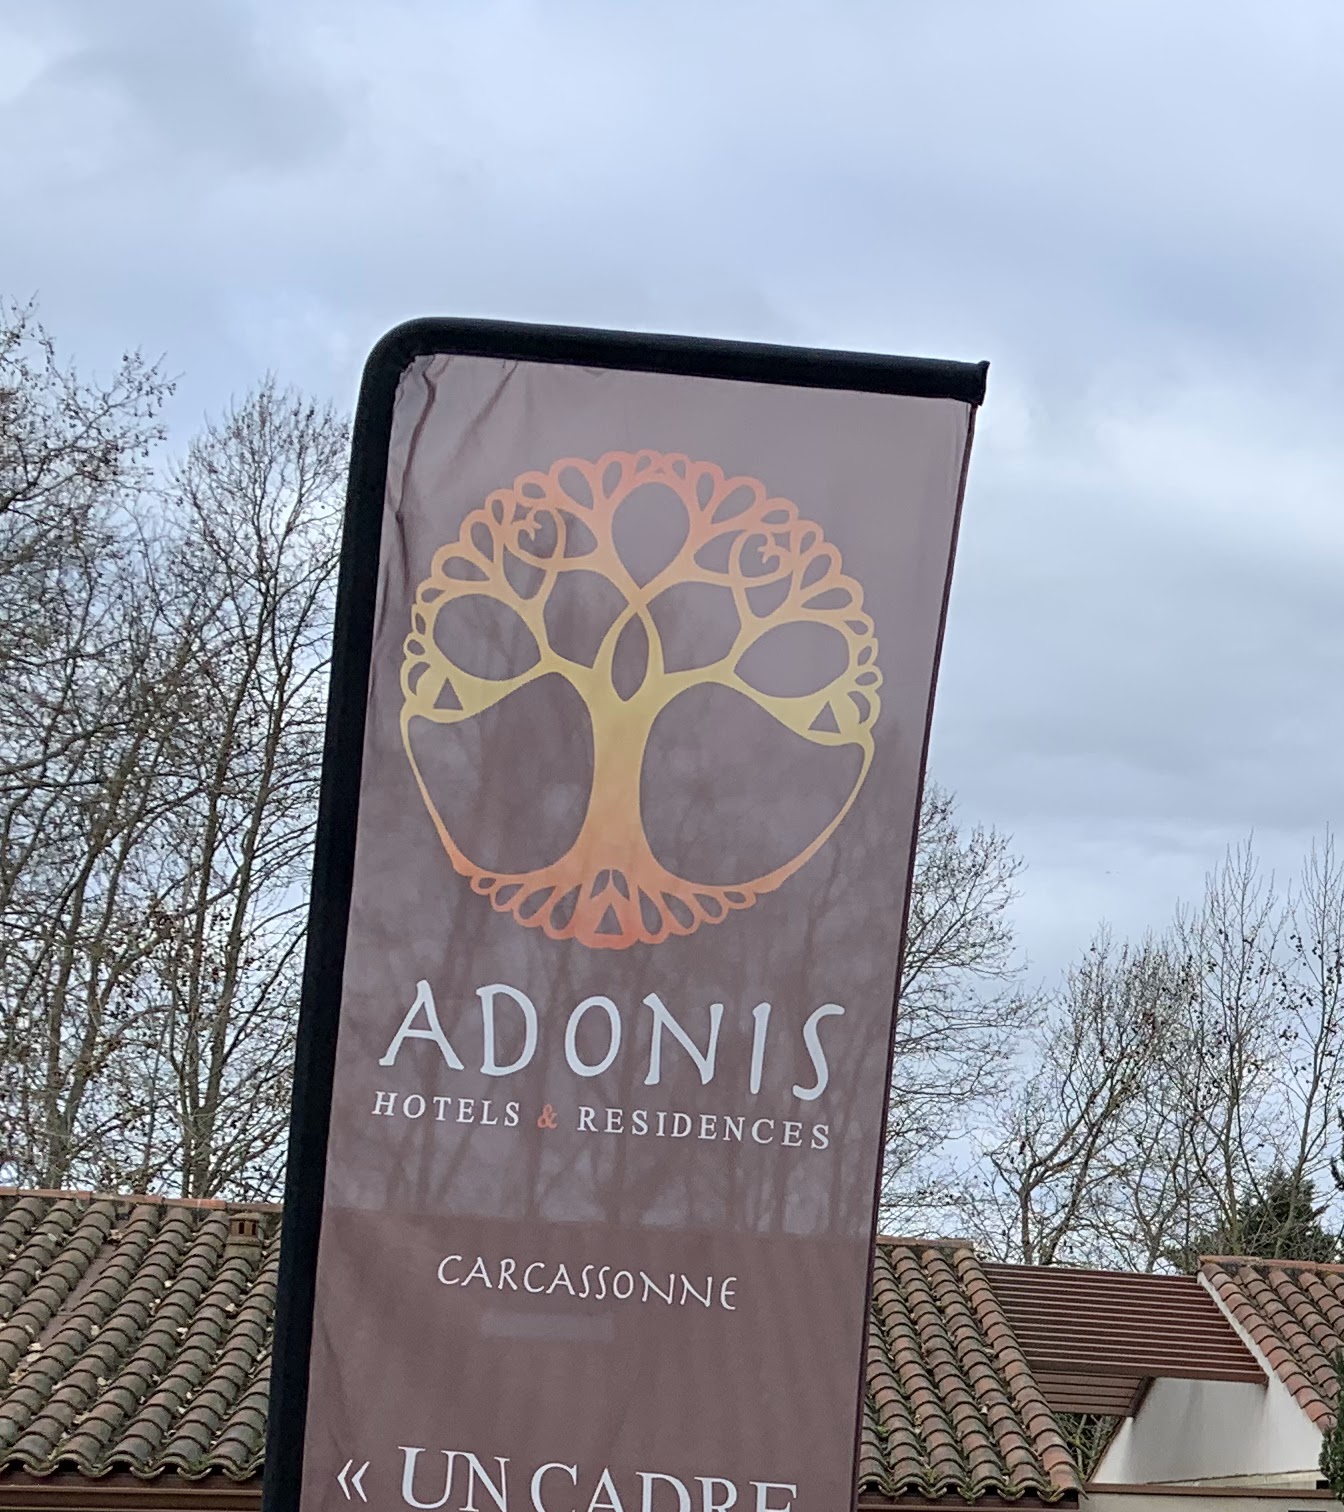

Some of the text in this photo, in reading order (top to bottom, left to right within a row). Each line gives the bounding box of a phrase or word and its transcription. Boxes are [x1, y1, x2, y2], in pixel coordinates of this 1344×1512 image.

[378, 979, 846, 1101] ADONIS
[371, 1090, 831, 1150] HOTELS & RESIDENCES
[437, 1254, 738, 1311] CARCASSONNE
